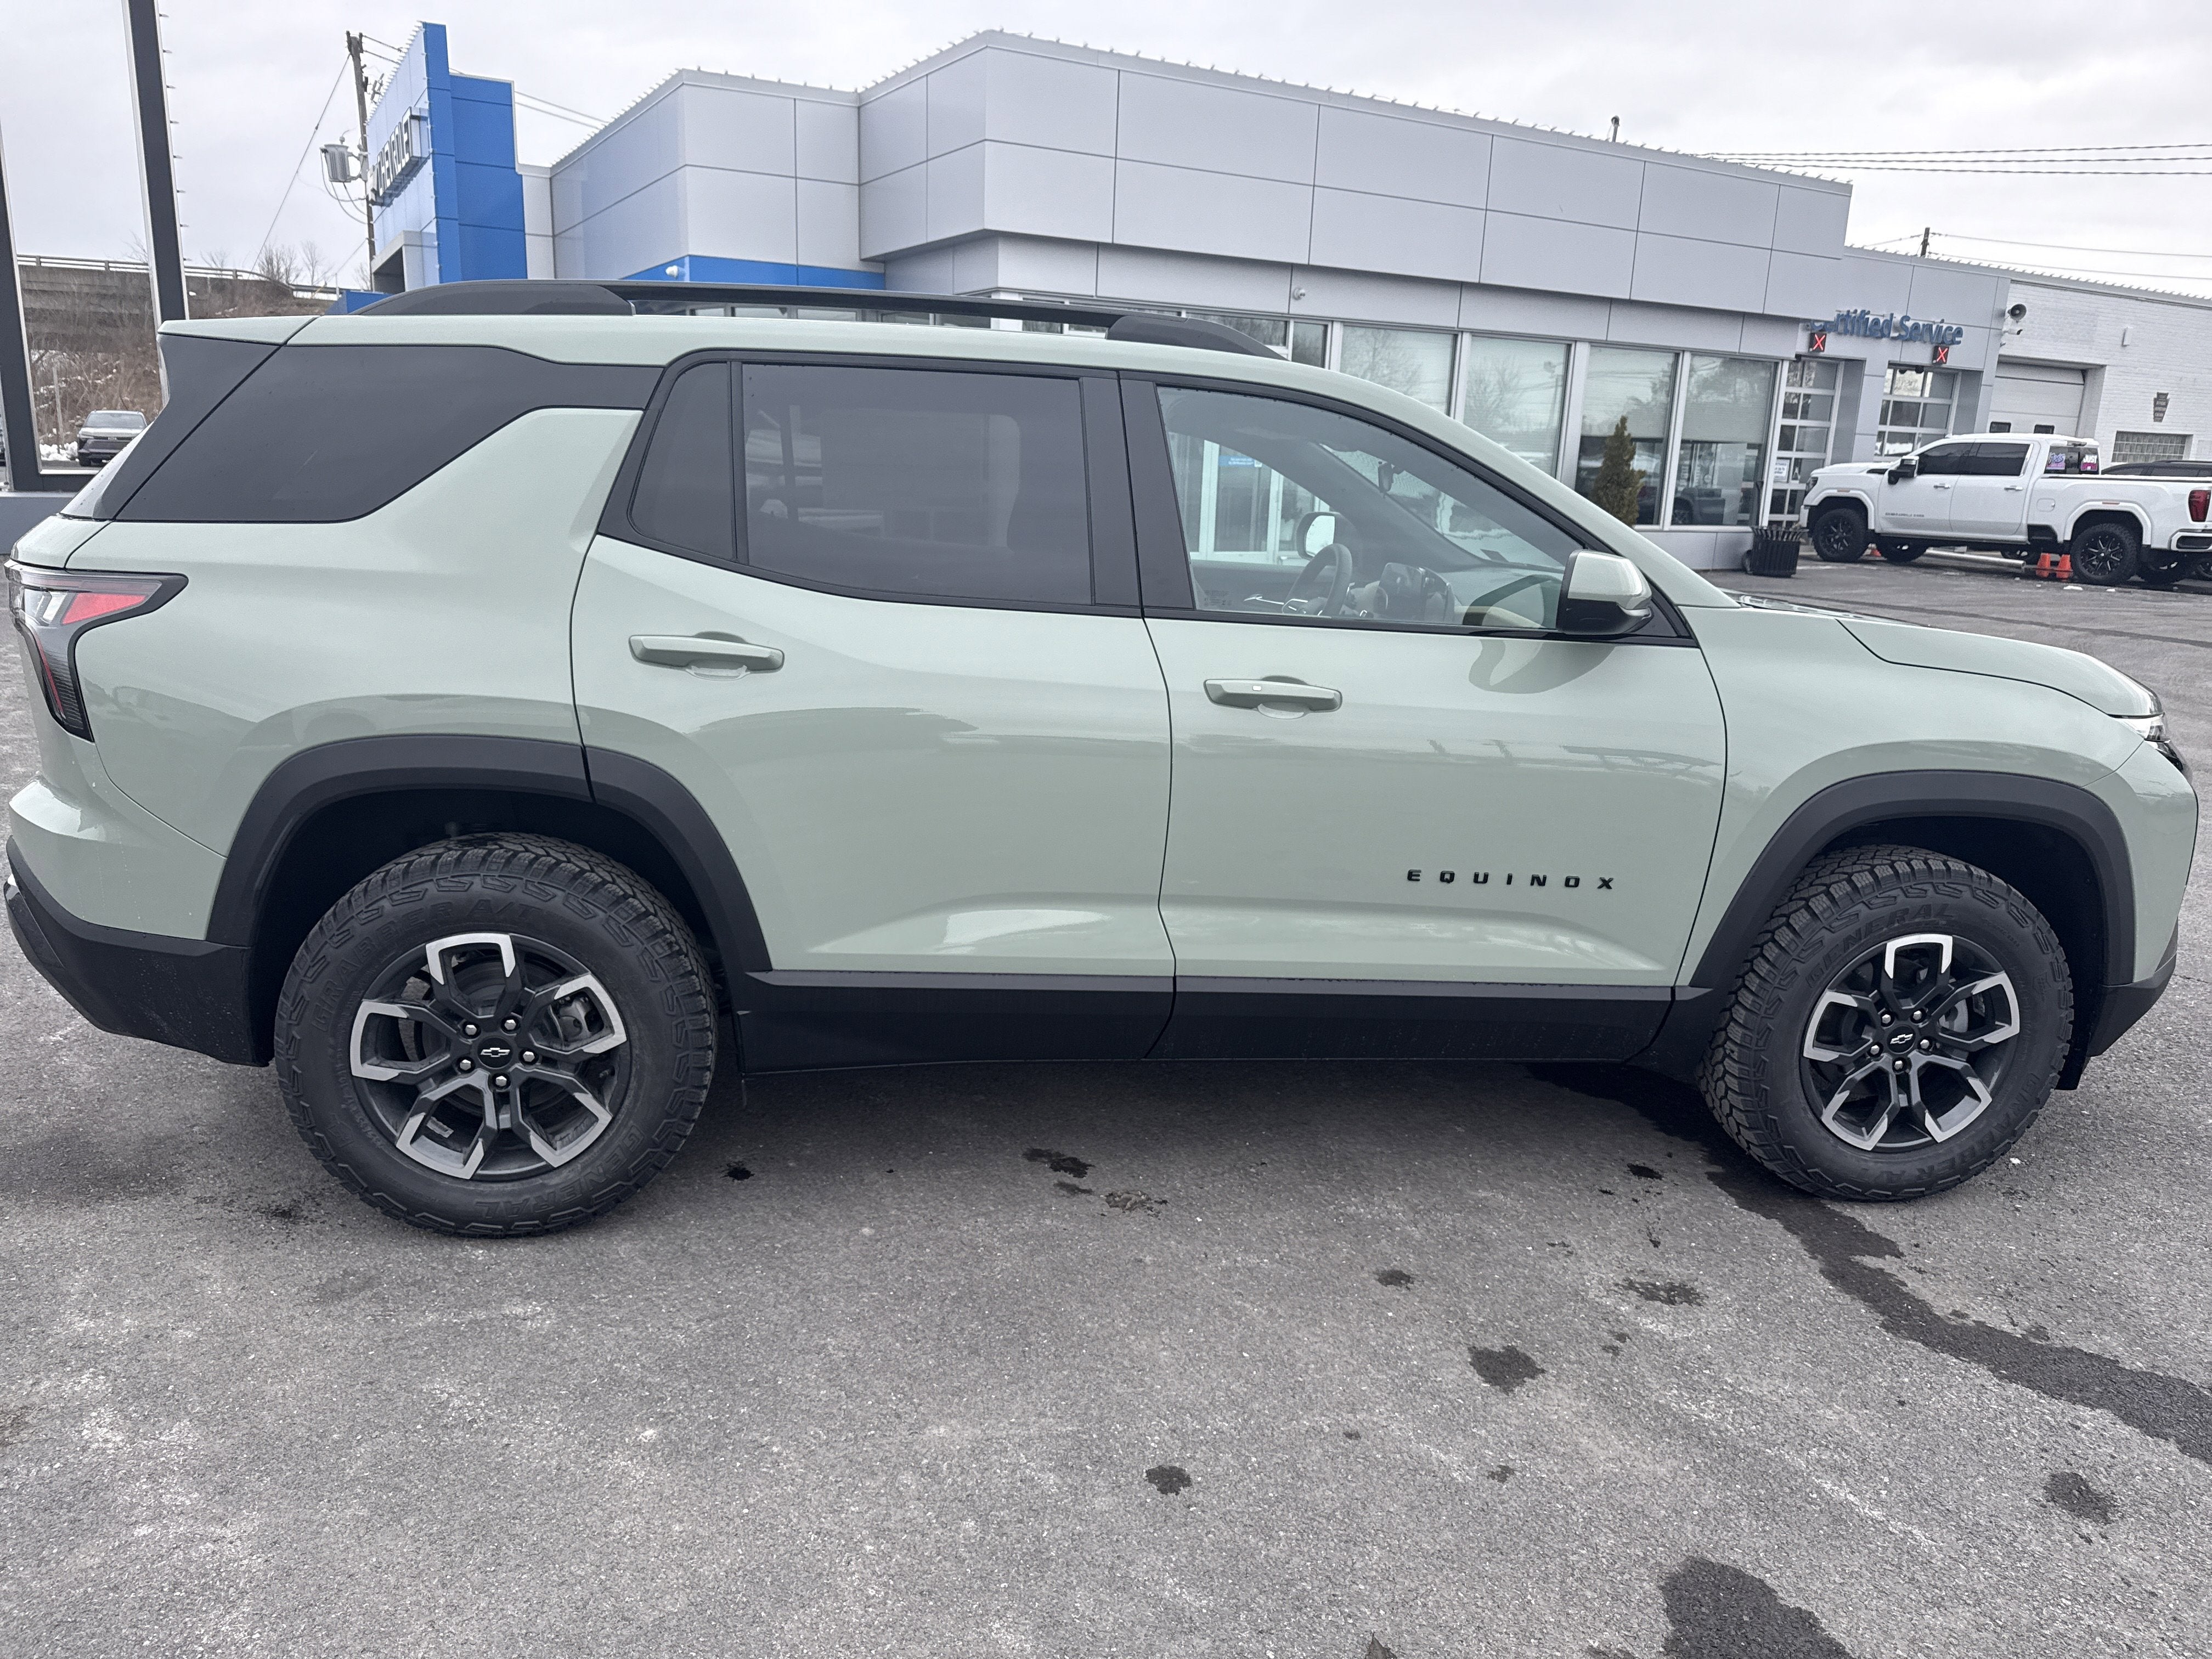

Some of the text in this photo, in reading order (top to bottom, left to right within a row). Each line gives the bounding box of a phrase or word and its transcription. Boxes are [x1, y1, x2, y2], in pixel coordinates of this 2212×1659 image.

[1897, 315, 1963, 346] Service
[1407, 869, 1614, 889] EQUINOX
[312, 900, 453, 1033] GRABBER
[1805, 902, 1957, 990] GENERAL
[473, 1122, 645, 1219] GENERAL
